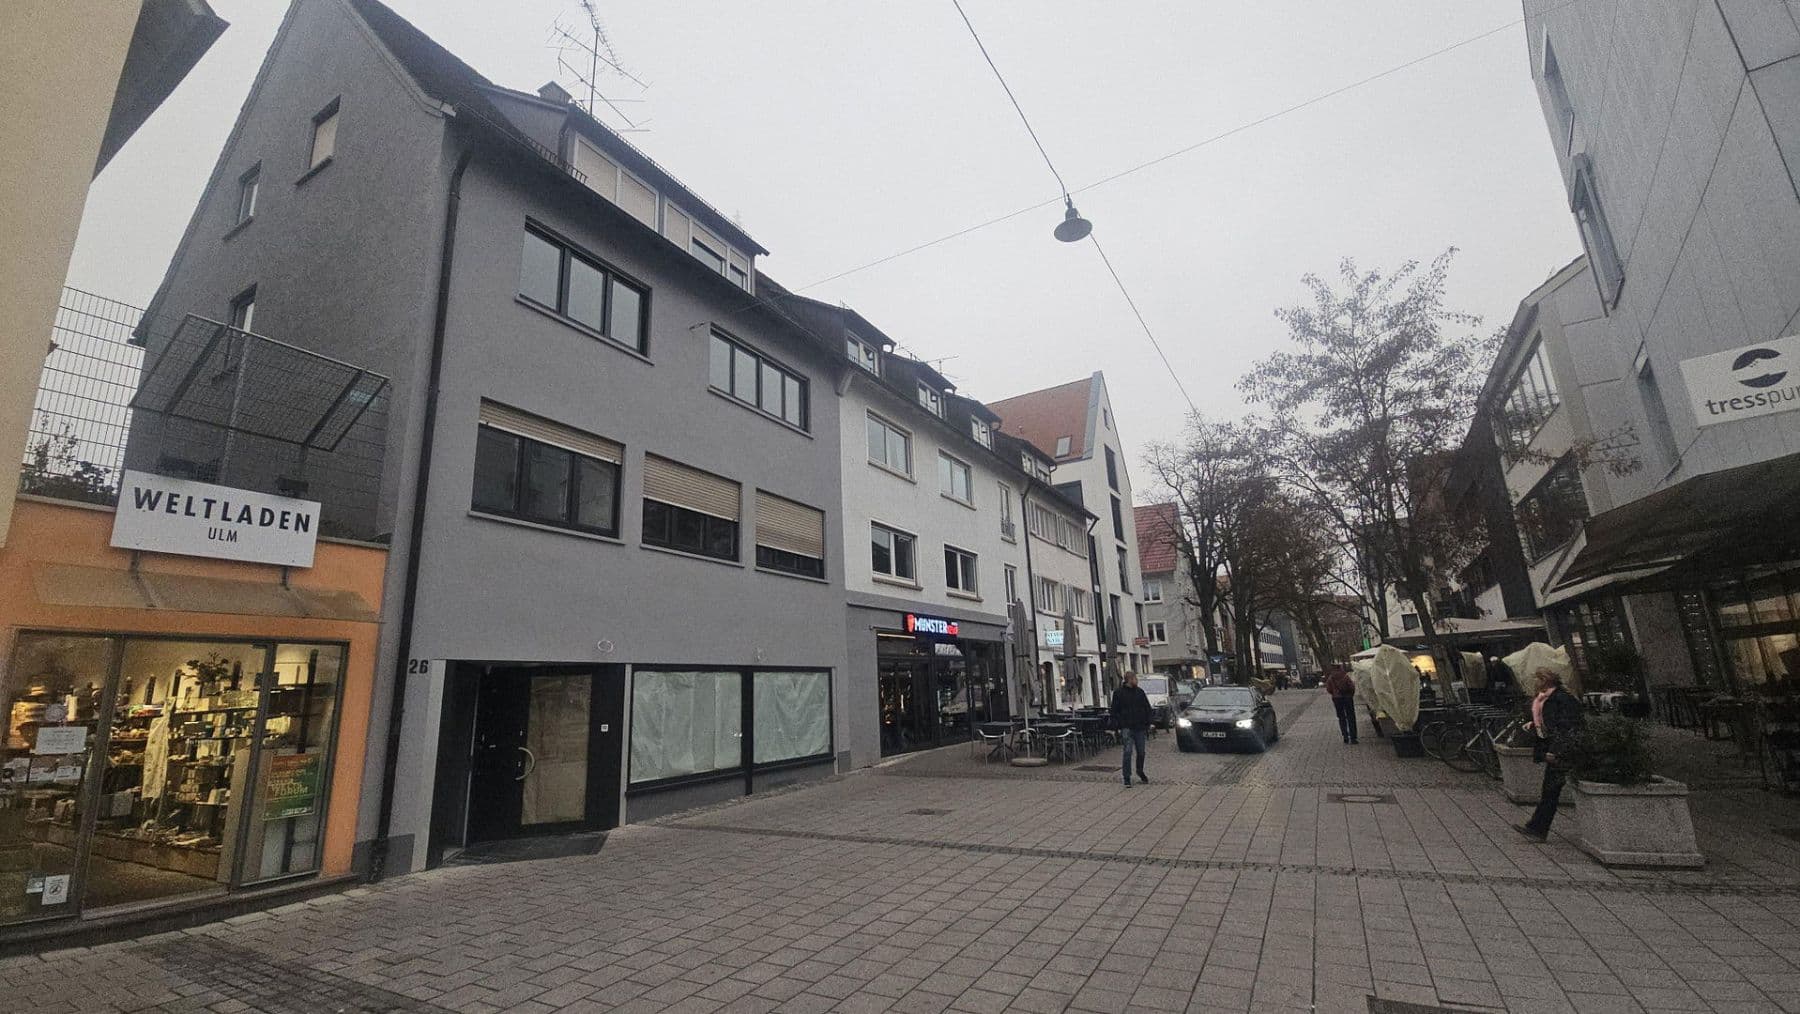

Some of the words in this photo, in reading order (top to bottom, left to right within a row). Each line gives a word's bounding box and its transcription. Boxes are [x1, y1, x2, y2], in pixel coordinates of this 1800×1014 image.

[134, 486, 311, 532] WELTLADEN
[208, 527, 238, 542] ULM
[409, 658, 428, 674] 26
